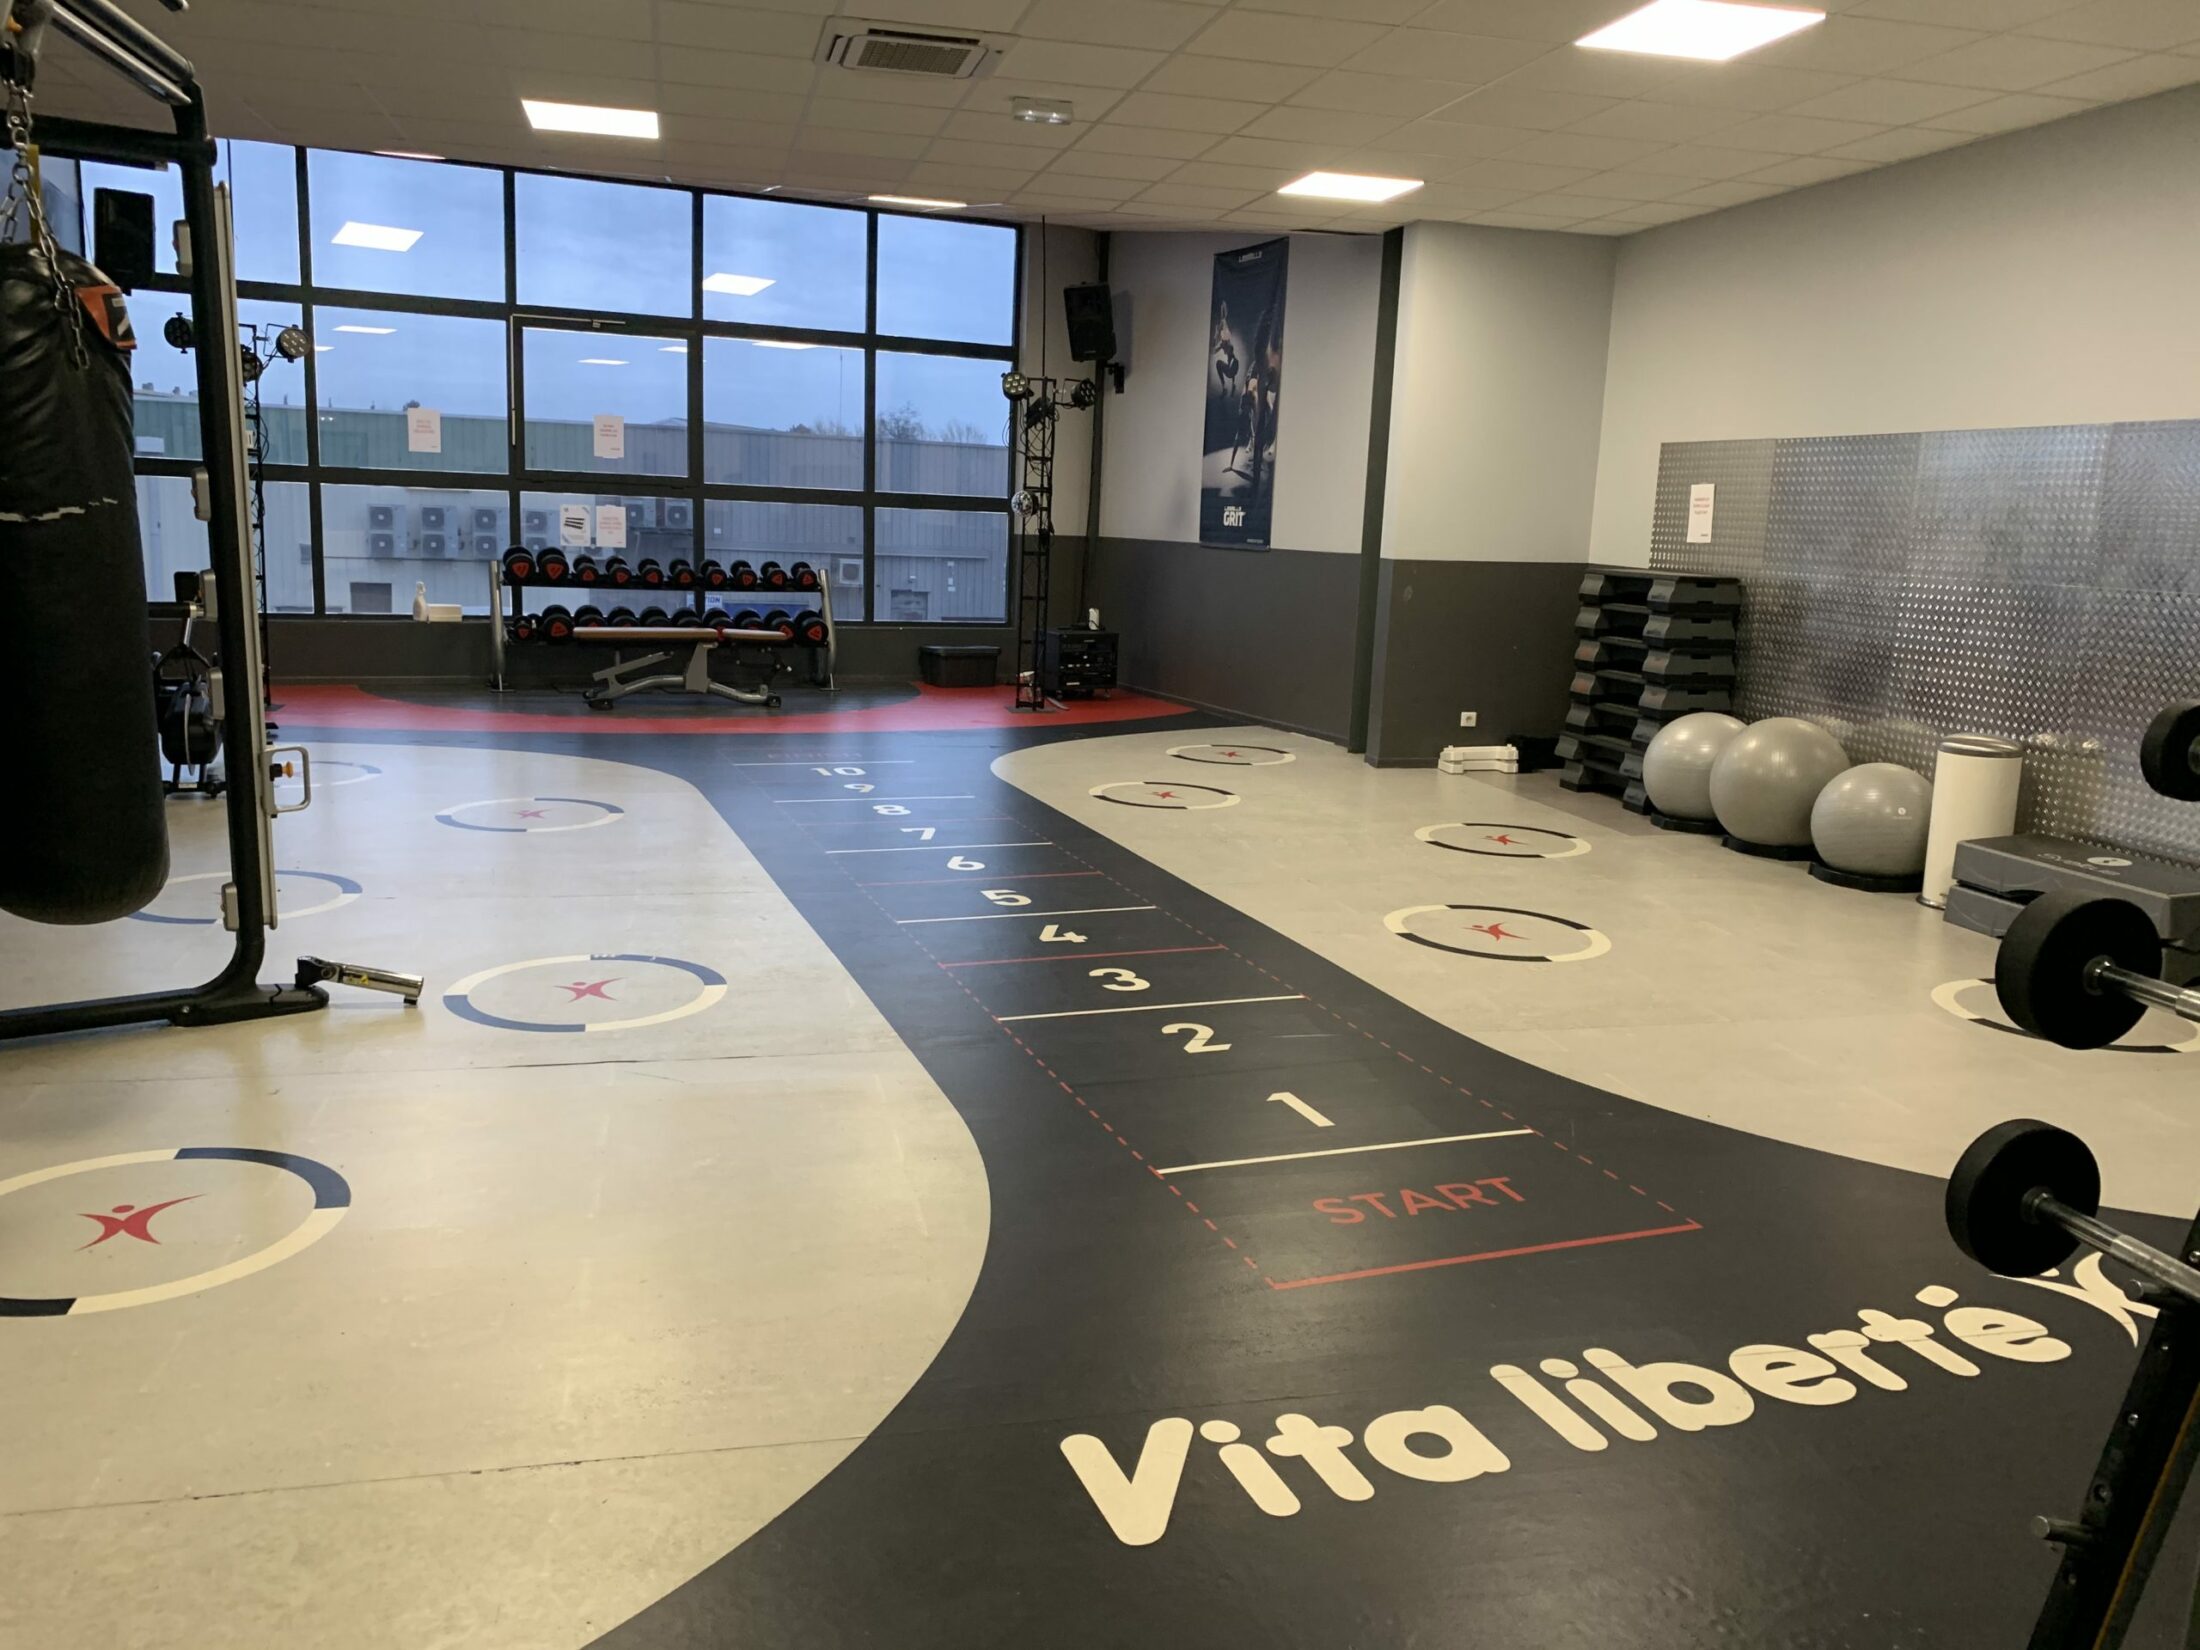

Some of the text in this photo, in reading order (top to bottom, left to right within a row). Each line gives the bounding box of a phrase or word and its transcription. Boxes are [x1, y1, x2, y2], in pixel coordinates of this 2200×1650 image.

[1223, 511, 1246, 527] GRIT
[812, 766, 866, 776] 10
[843, 783, 875, 793] 9
[872, 804, 912, 816] 8
[900, 827, 936, 841] 7
[946, 855, 986, 871] 6
[980, 889, 1032, 906] 5
[1038, 924, 1089, 943] 4
[1088, 967, 1151, 991] 3
[1161, 1022, 1233, 1054] 2
[1266, 1091, 1336, 1128] 1
[1312, 1176, 1526, 1225] START
[1060, 1405, 1511, 1547] Vita
